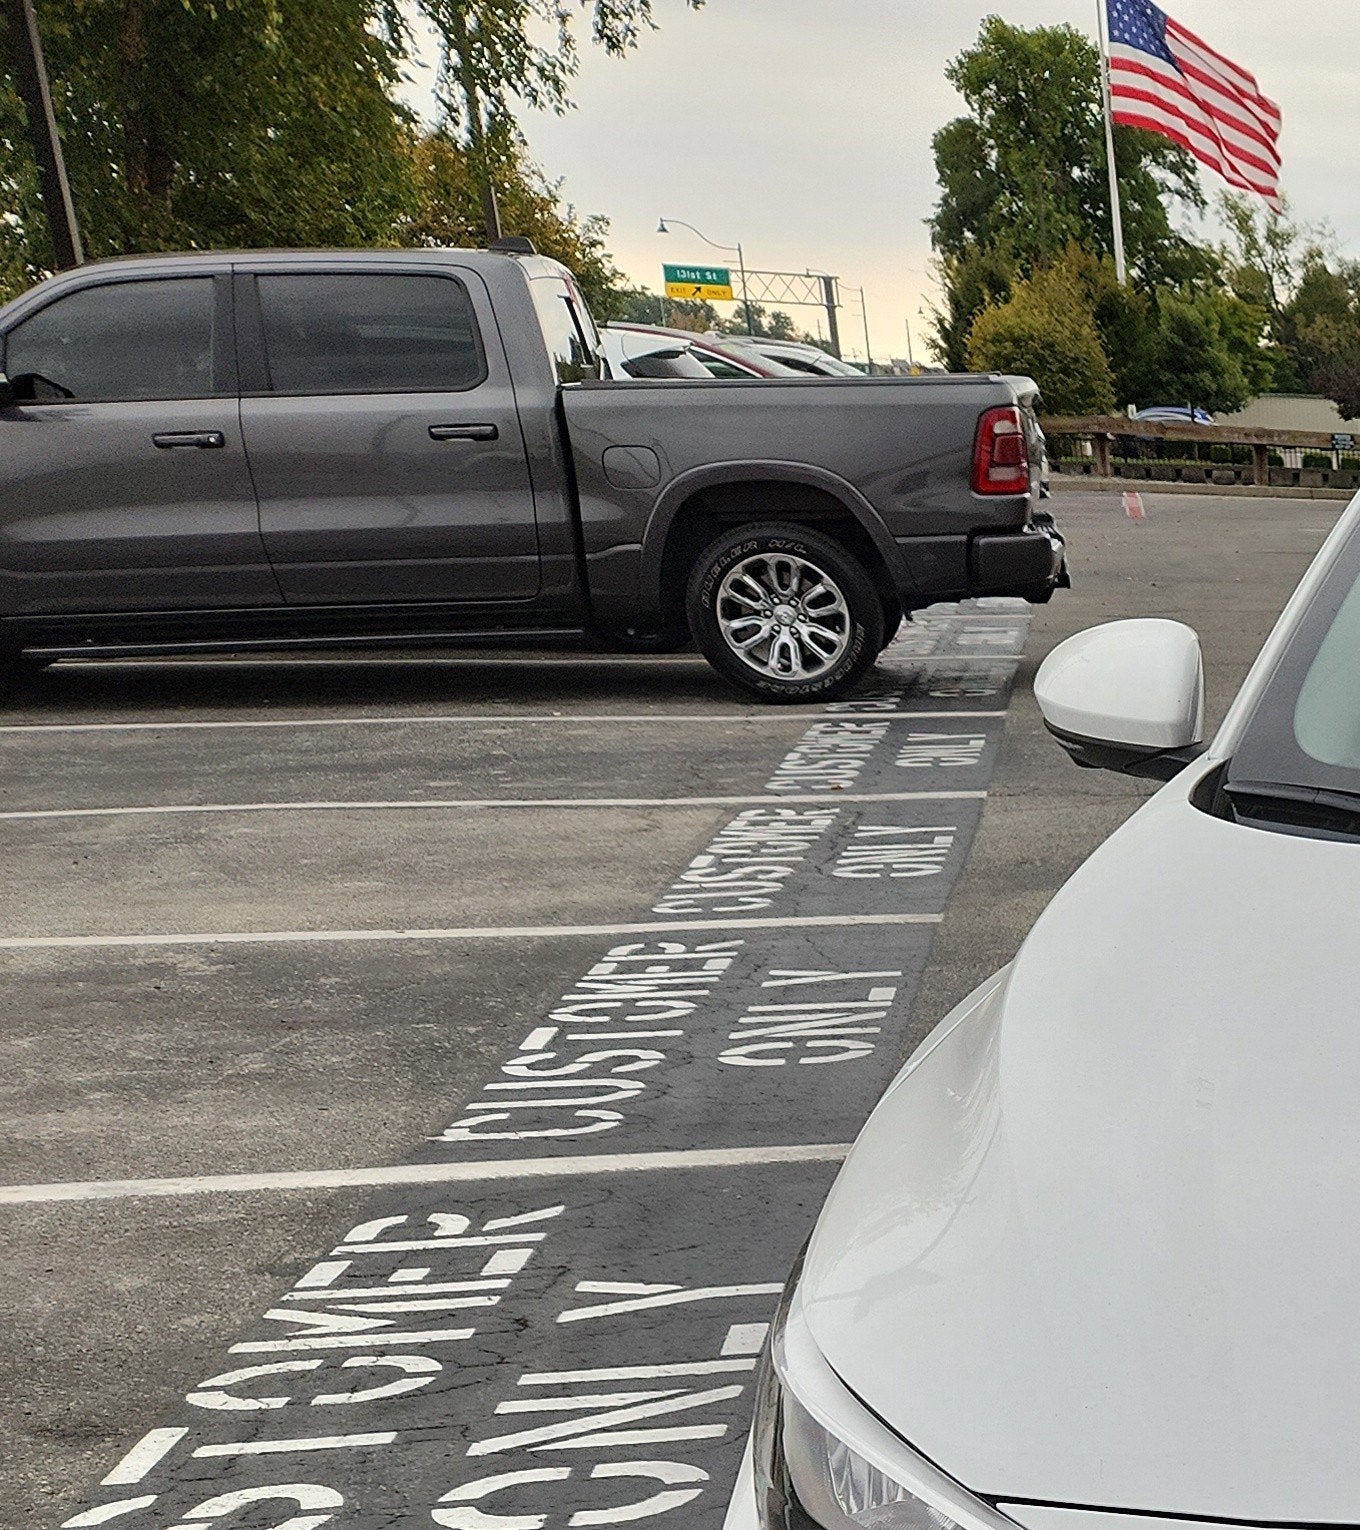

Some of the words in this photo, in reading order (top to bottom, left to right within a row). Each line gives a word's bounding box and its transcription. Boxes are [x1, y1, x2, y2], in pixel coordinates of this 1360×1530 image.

[676, 269, 700, 280] 131st
[706, 272, 717, 280] St
[895, 732, 987, 767] ONLY
[651, 808, 841, 914] CUSTOMER
[832, 825, 958, 878] ONLY
[426, 938, 745, 1142] CUSTOMER
[717, 969, 903, 1067] ONLY
